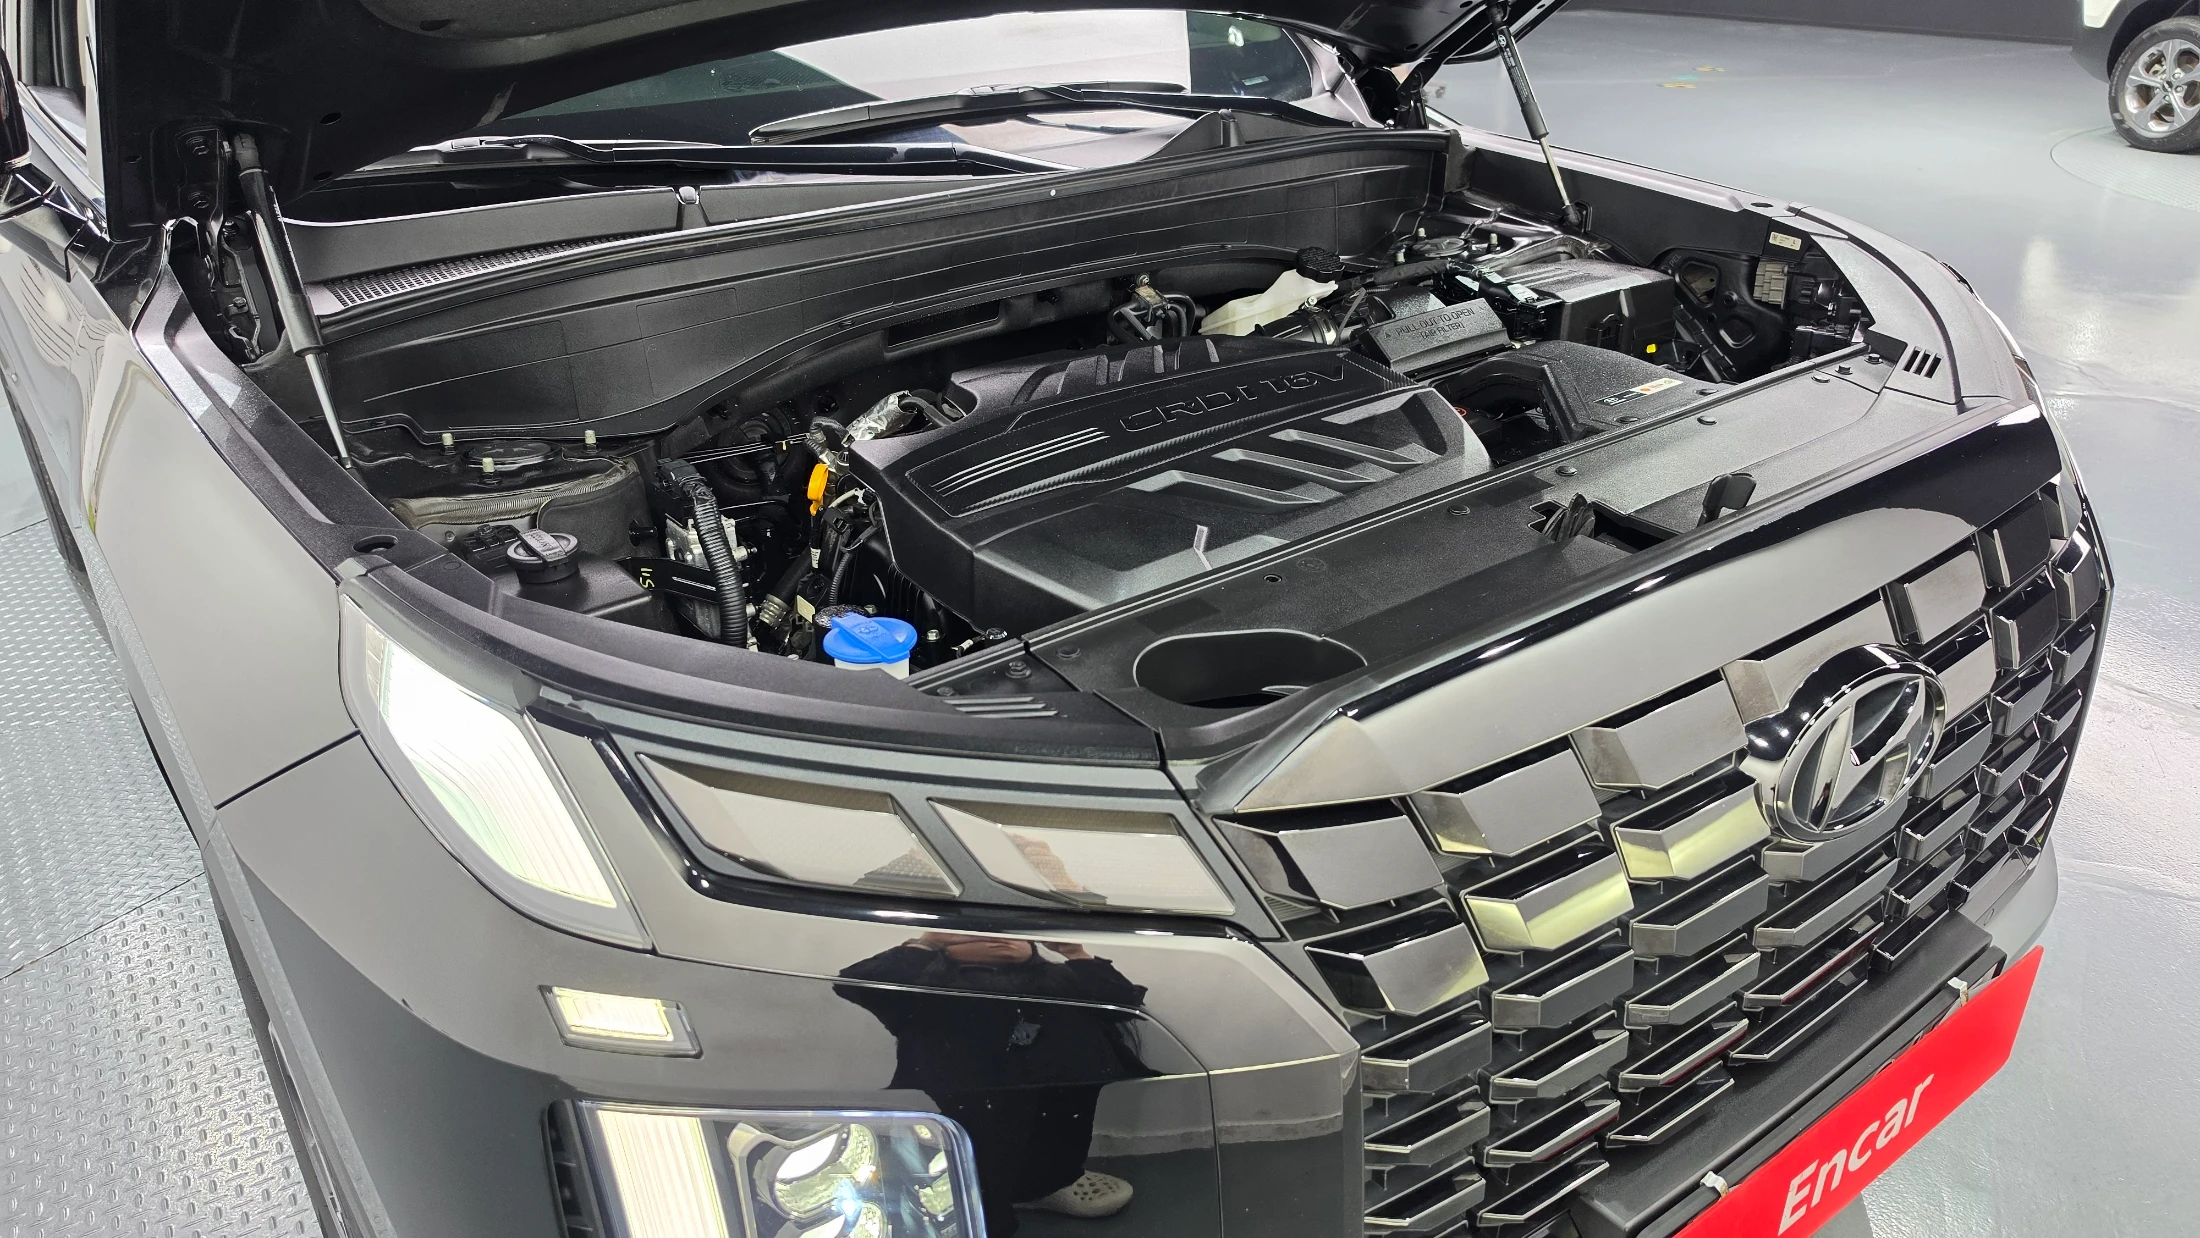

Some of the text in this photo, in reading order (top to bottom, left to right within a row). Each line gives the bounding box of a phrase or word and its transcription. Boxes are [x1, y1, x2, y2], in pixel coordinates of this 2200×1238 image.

[1395, 308, 1475, 337] PULL OUT TO OPEN
[1777, 1073, 1935, 1237] Encar
